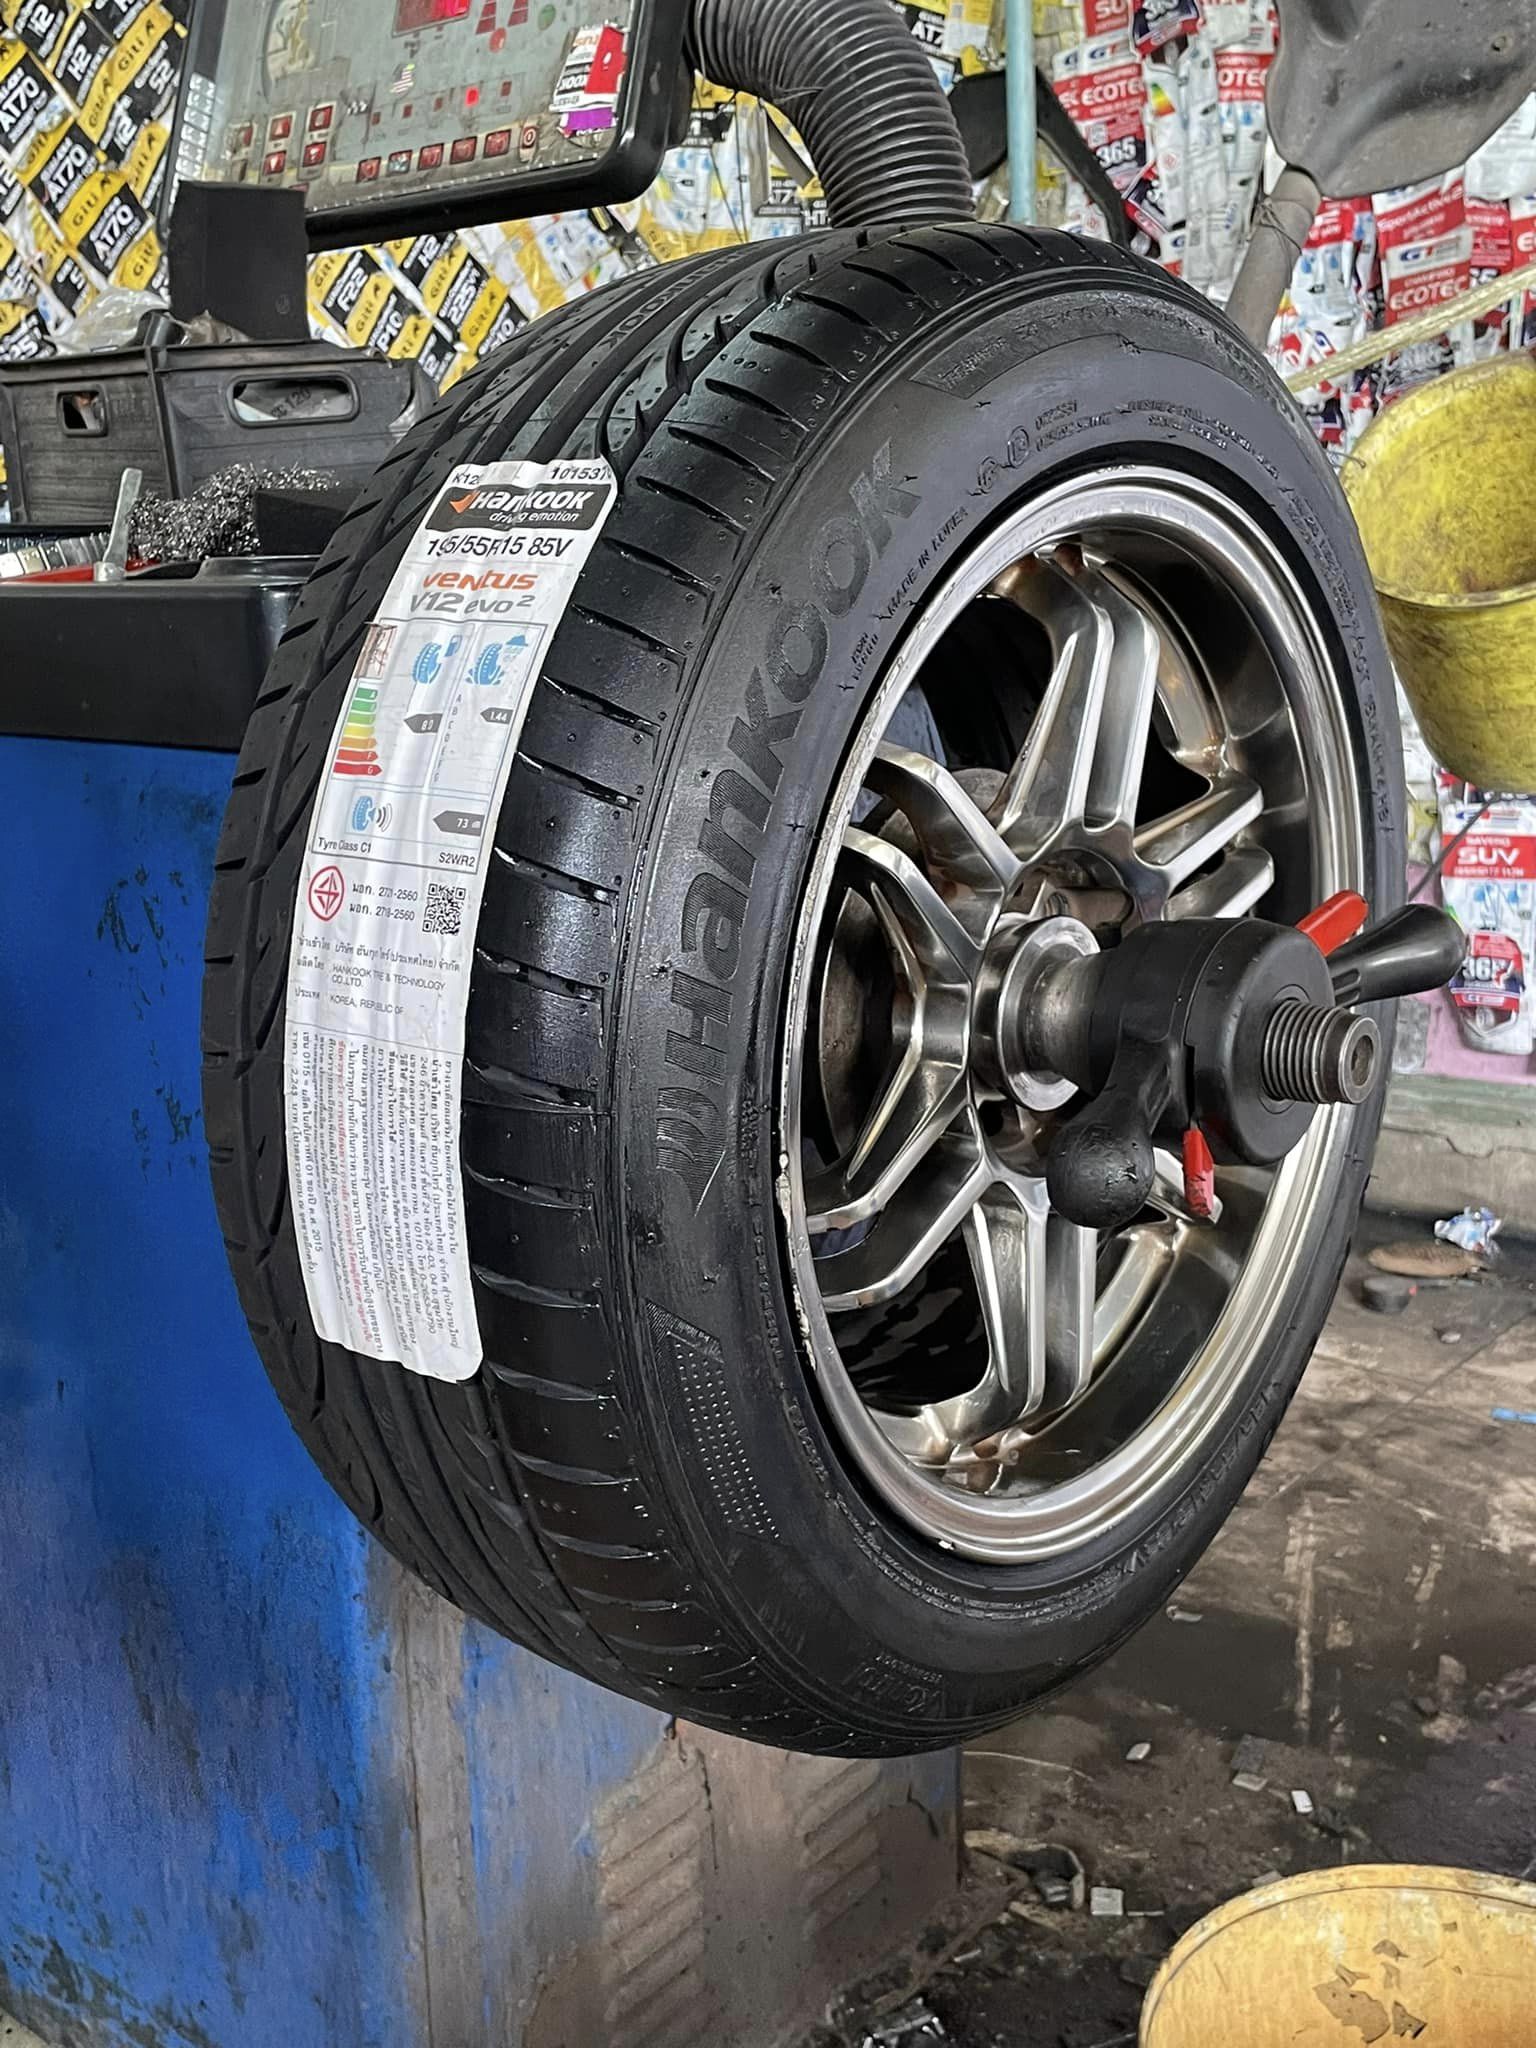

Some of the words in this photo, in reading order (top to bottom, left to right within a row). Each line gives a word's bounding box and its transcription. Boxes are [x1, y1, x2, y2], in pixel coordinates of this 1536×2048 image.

[67, 44, 93, 82] H2
[1096, 135, 1137, 169] 365
[47, 143, 88, 204] AT70
[72, 192, 99, 227] Giti
[93, 204, 134, 263] AT70
[337, 266, 369, 313] F22
[430, 270, 448, 299] Giti
[1390, 274, 1468, 310] ECOTEC
[355, 303, 376, 333] Giti
[469, 309, 489, 338] Giti
[529, 510, 580, 524] emotion
[527, 537, 573, 557] 85V
[409, 590, 465, 614] V12
[456, 817, 469, 829] 73
[317, 836, 338, 851] Tyre
[360, 841, 373, 853] C1
[1457, 847, 1520, 867] SUV
[438, 852, 477, 868] S2WR2
[393, 974, 446, 991] TECHNOLOGY
[420, 1056, 429, 1077] 246
[302, 1051, 311, 1077] 0115
[311, 1229, 323, 1253] 2015
[414, 1222, 424, 1251] 10110
